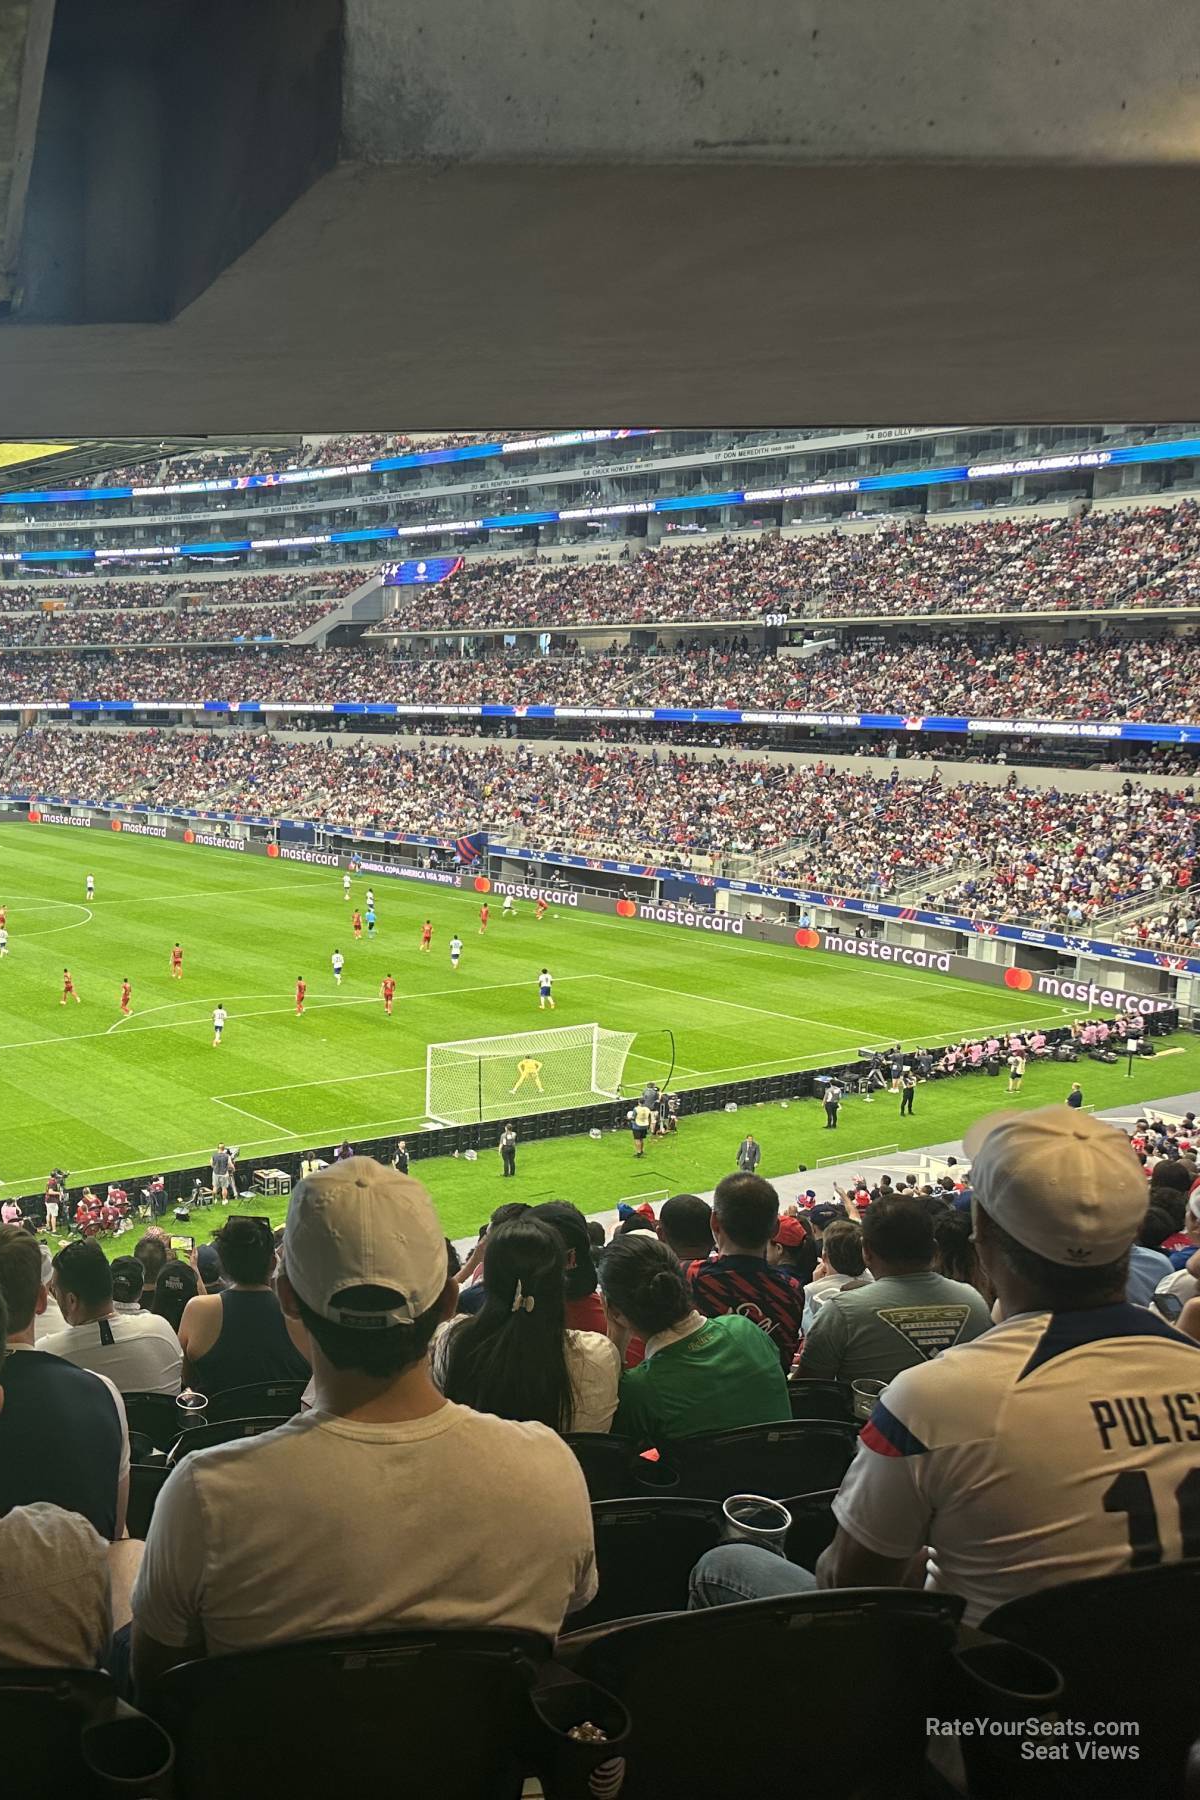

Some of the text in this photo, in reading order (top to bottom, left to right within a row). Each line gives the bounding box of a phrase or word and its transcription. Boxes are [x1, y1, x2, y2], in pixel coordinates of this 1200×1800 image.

[723, 451, 736, 459] DON
[738, 448, 769, 456] MEREDITH
[1015, 722, 1040, 733] COPA
[1040, 723, 1078, 735] AMERICA
[42, 813, 91, 828] mastercard
[123, 822, 167, 838] mastercard
[195, 833, 245, 851] mastercard
[280, 846, 339, 867] mastercard
[385, 865, 400, 875] COPA
[400, 867, 425, 879] AMERICA
[427, 870, 437, 880] USA
[493, 879, 579, 907] mastercard
[639, 905, 743, 936] mastercard
[825, 934, 951, 972] mastercard
[1038, 975, 1174, 1015] mastercar
[1089, 1391, 1200, 1450] PULIS
